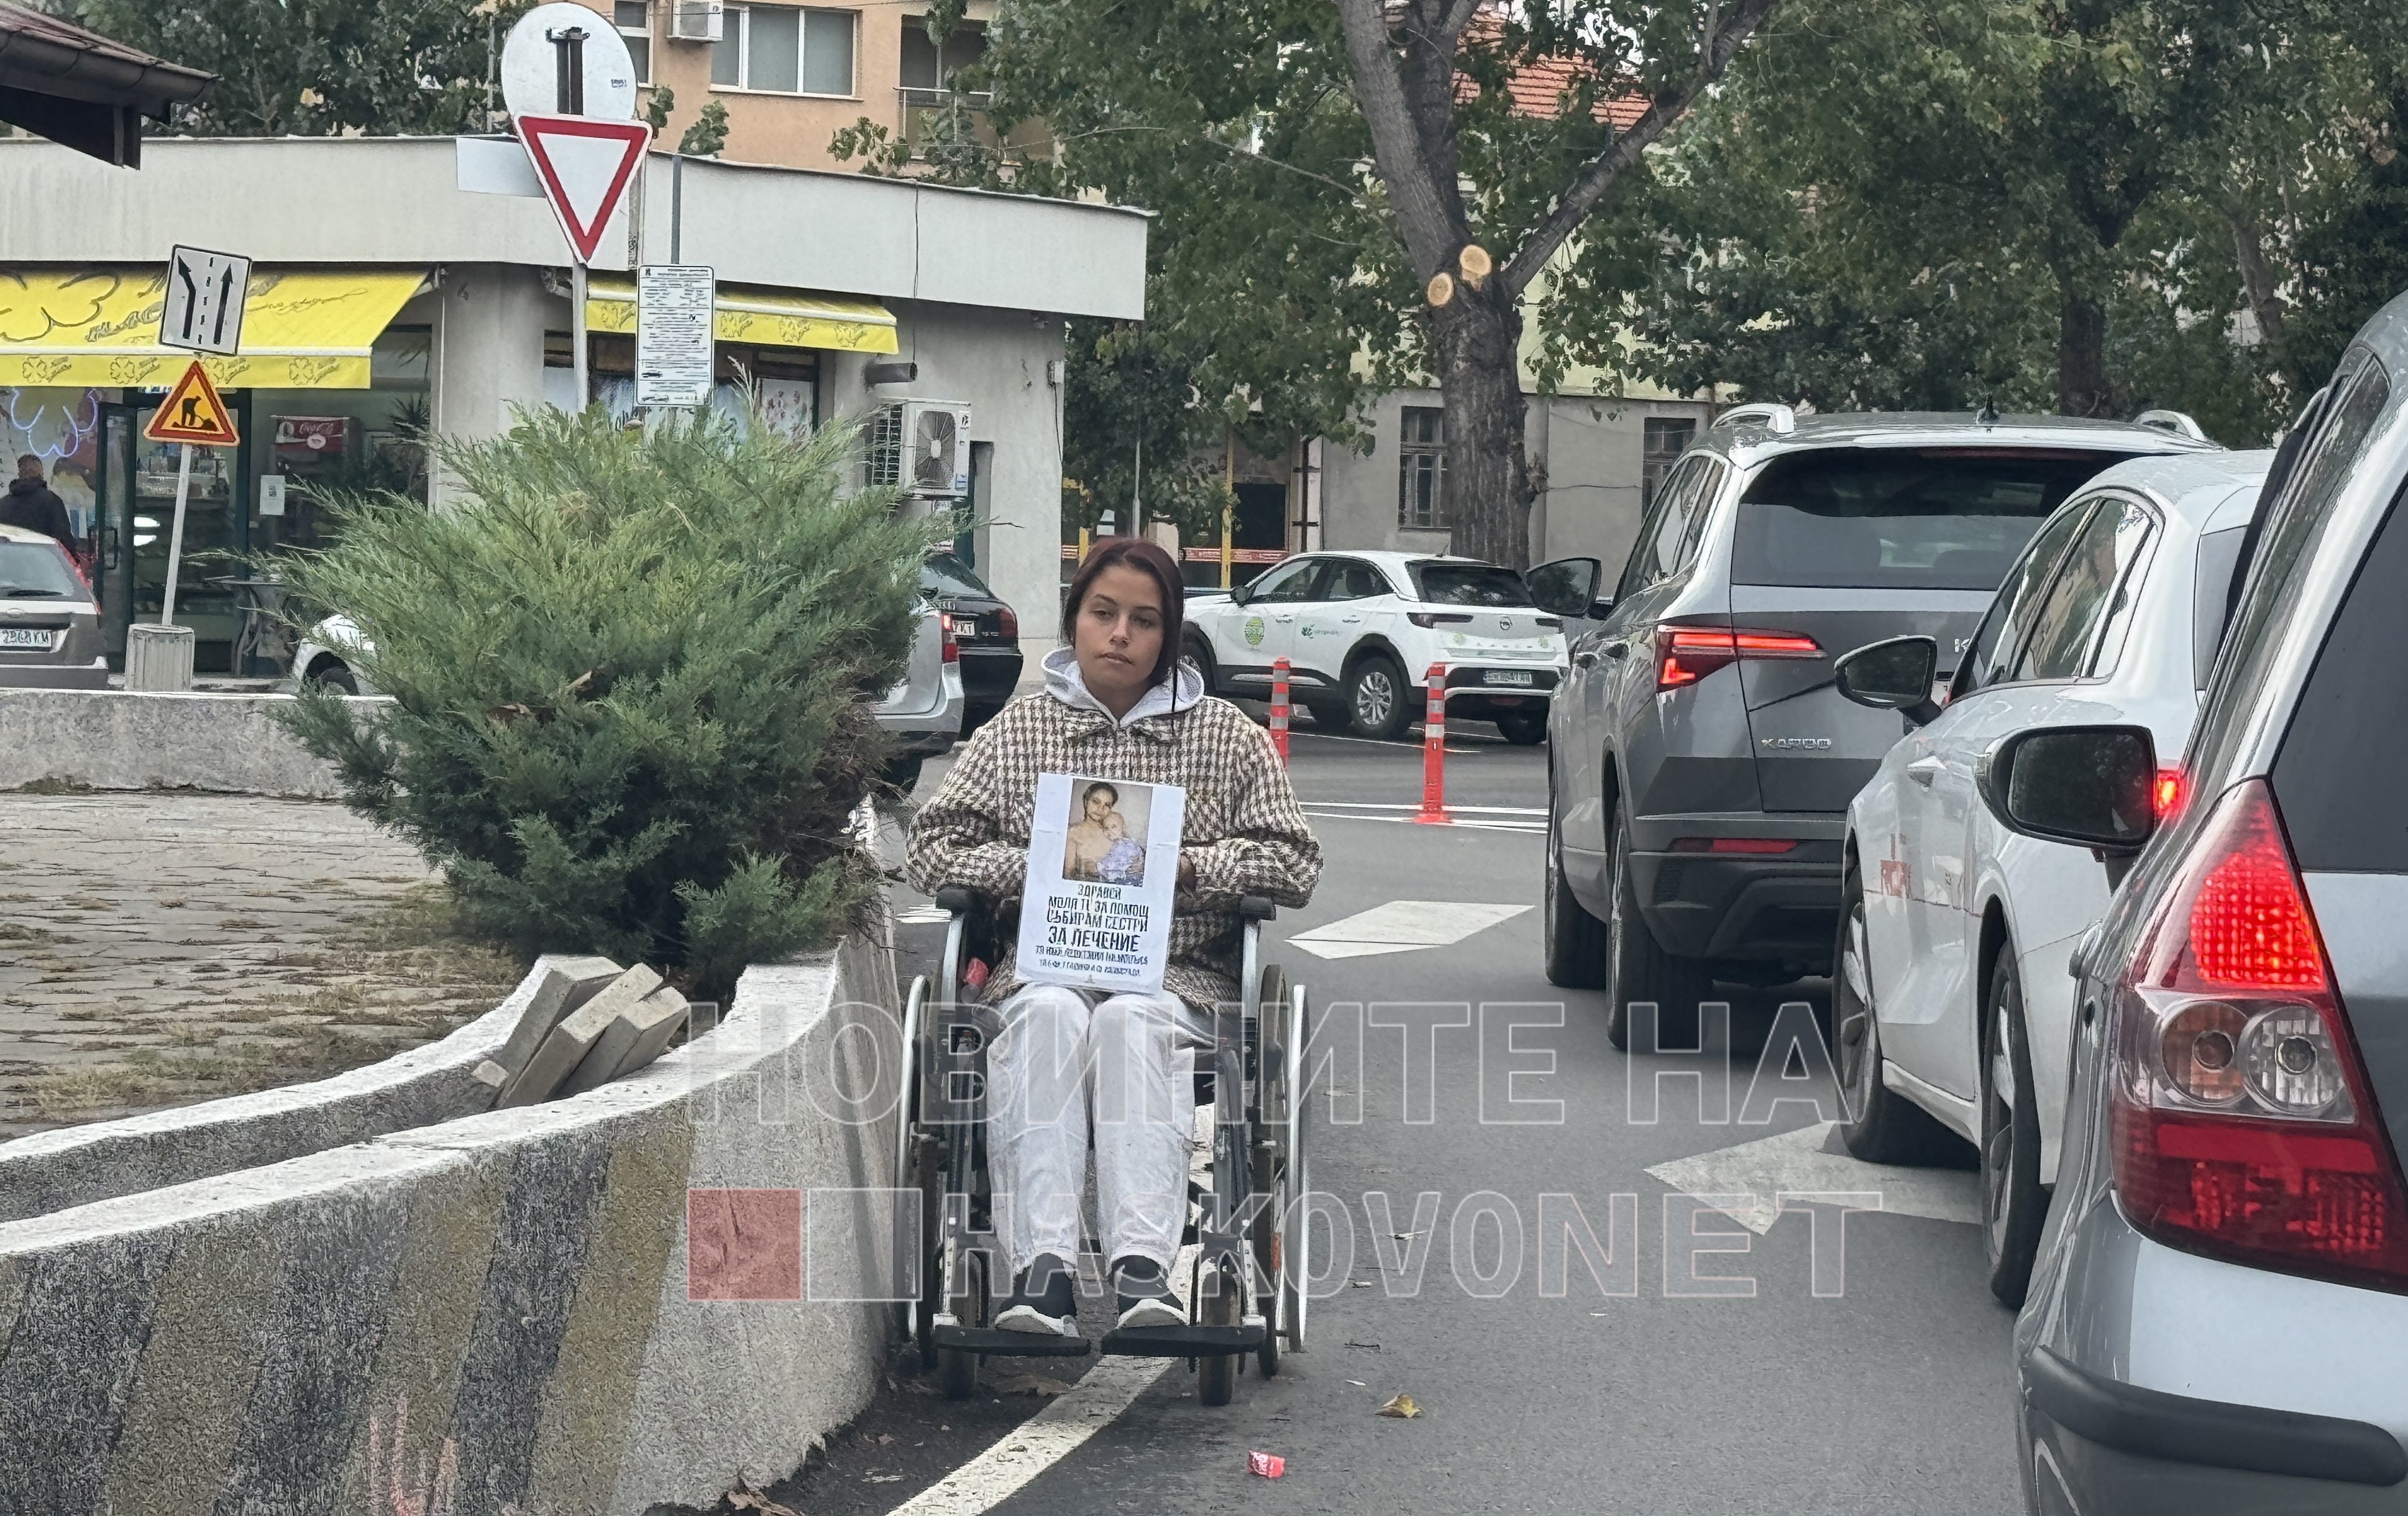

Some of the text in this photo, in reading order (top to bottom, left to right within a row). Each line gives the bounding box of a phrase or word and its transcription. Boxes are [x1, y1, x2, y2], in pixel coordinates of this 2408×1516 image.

[1761, 738, 1833, 750] KAROQ
[1094, 901, 1107, 914] ЗА
[1110, 902, 1149, 917] ПОМОЩ
[1048, 925, 1141, 952] ЗА ЛЕЧЕНИЕ
